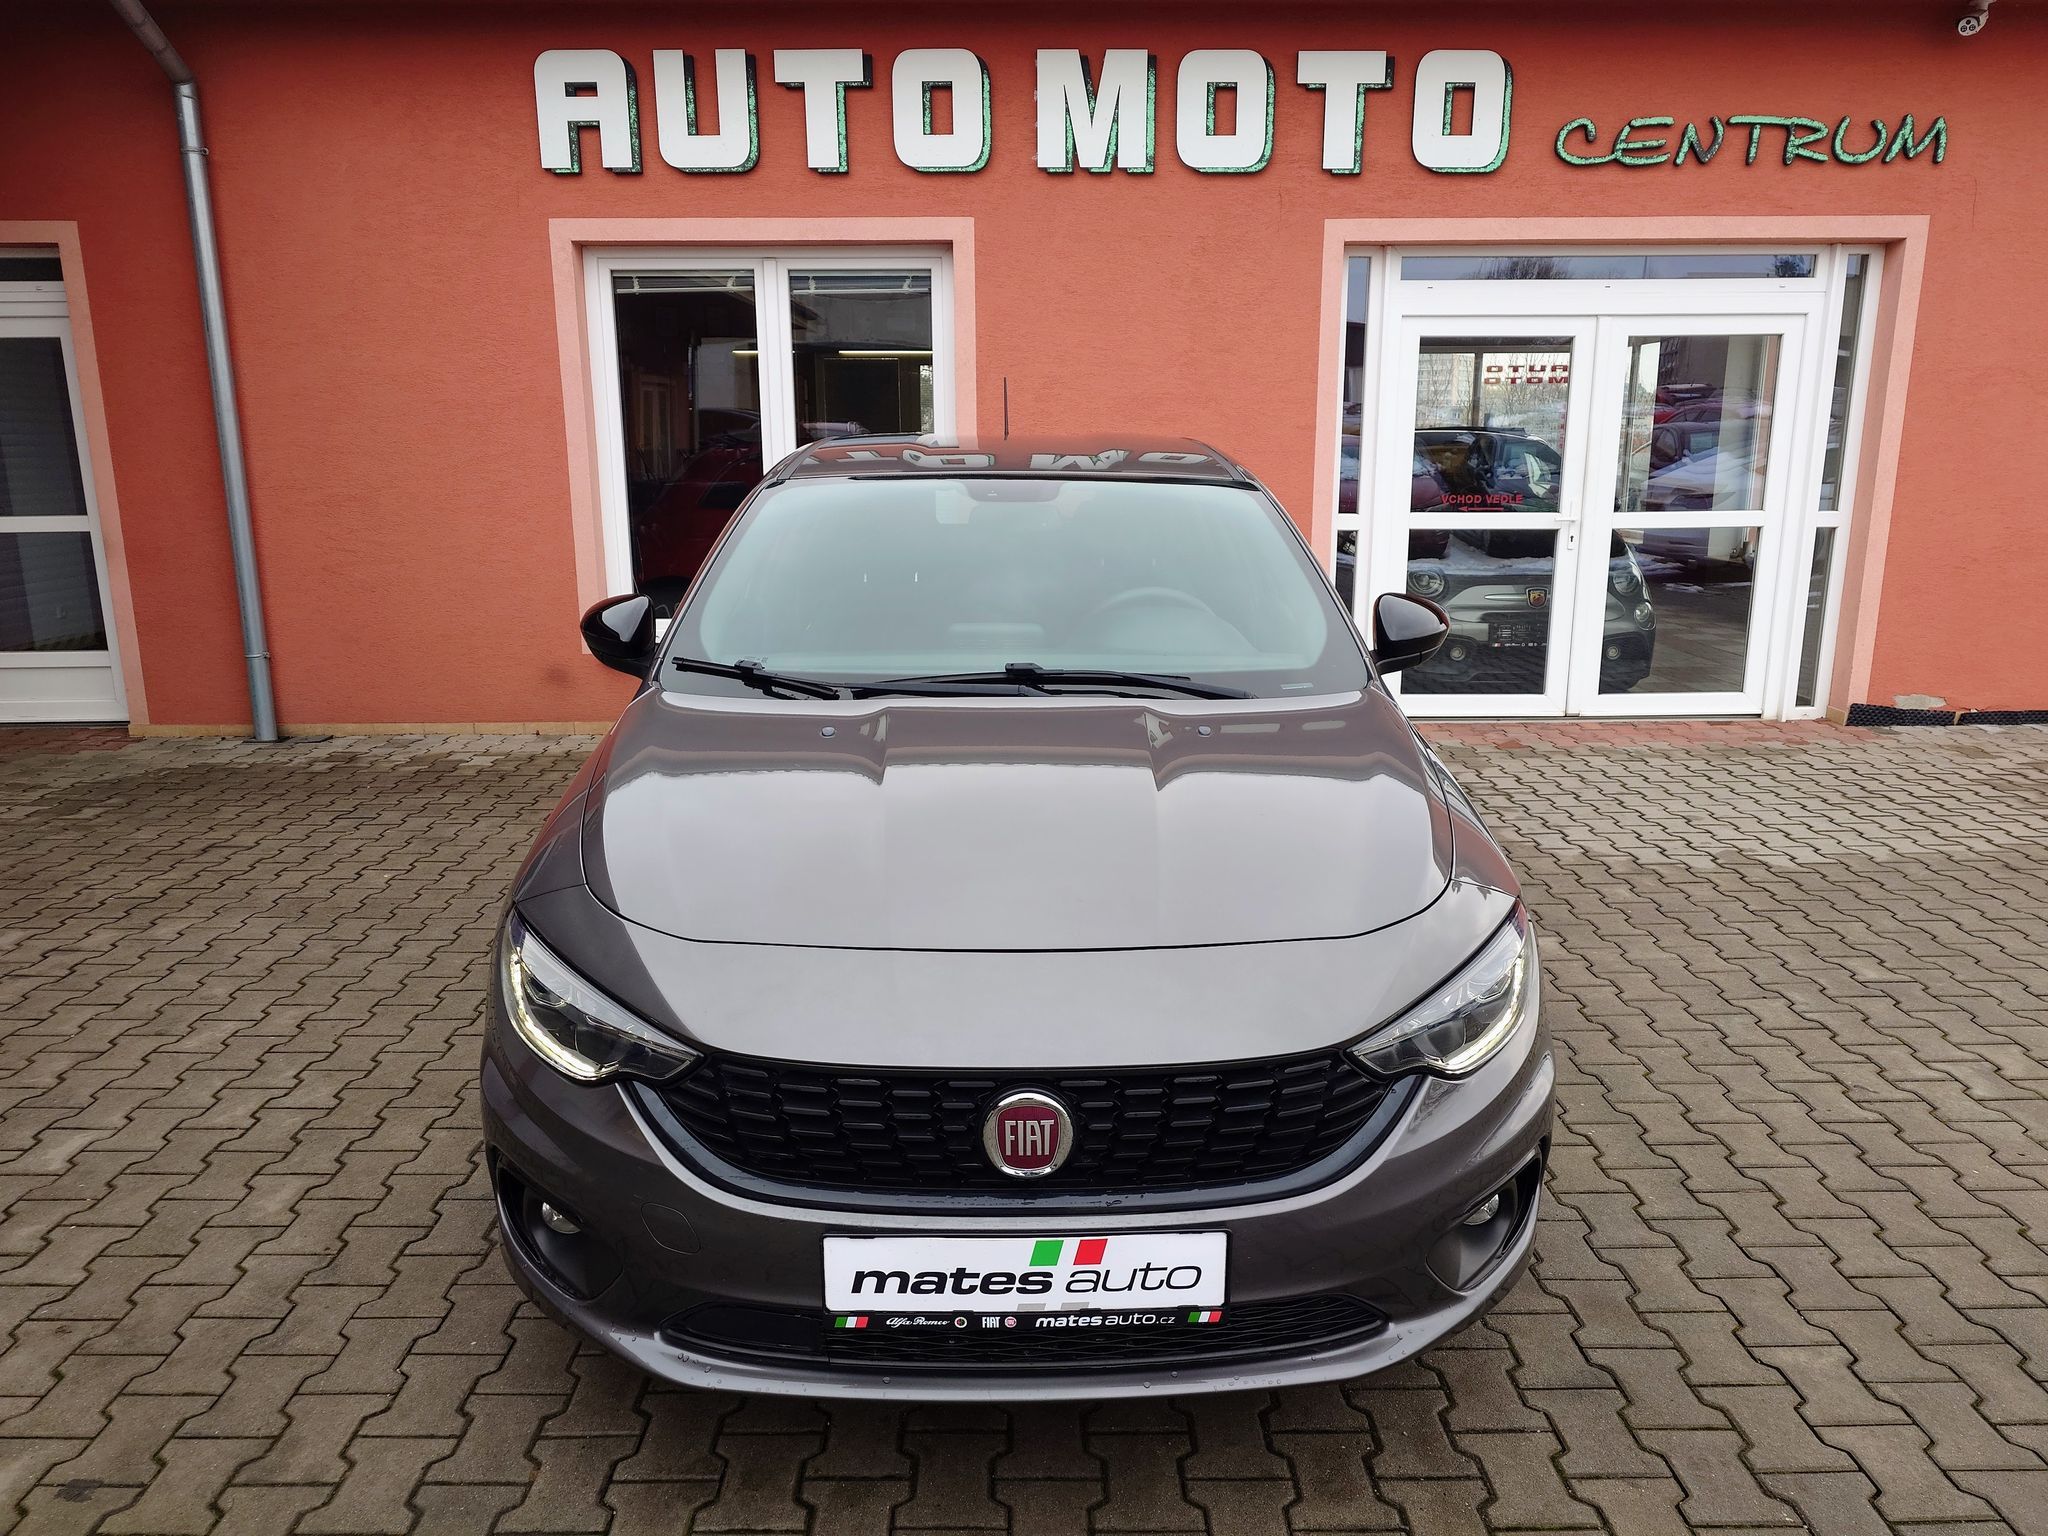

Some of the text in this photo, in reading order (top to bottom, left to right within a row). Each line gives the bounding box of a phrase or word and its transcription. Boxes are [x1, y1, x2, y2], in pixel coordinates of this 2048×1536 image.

[534, 48, 1948, 174] AUTO MOTO CENTRUM
[1441, 493, 1523, 504] VCHOD VEDLE
[1004, 1120, 1055, 1156] FIAT
[850, 1262, 1203, 1295] mates auto
[981, 1316, 1001, 1329] FIAT
